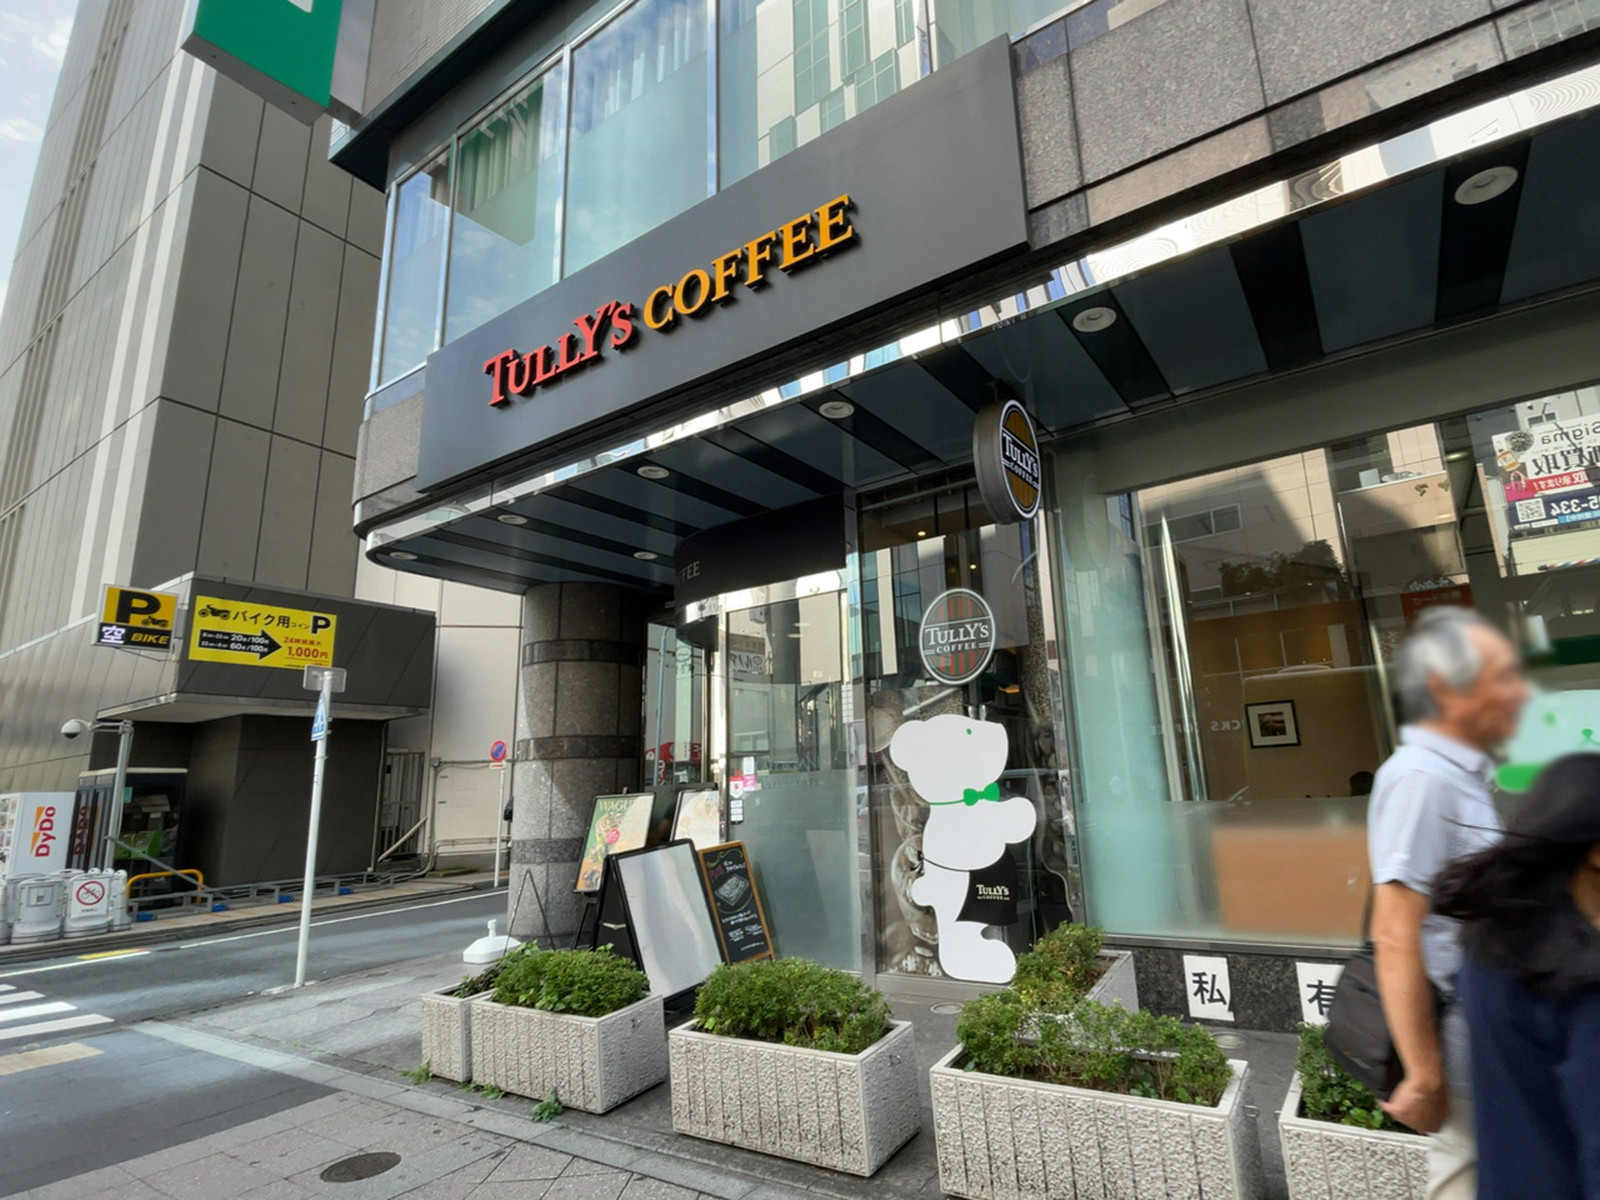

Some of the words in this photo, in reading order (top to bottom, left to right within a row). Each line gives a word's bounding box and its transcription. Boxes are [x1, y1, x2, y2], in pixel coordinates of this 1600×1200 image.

[483, 300, 634, 406] TULLY'S
[643, 193, 854, 330] COFFEE
[1002, 432, 1039, 478] TULLY'S
[116, 589, 161, 624] P
[232, 610, 291, 629] バイク用
[311, 615, 331, 634] P
[925, 622, 989, 645] TULLY'S
[101, 626, 126, 644] 空
[130, 632, 170, 645] BIKE
[287, 646, 328, 659] 1,000円
[936, 642, 977, 654] COFFEE
[35, 806, 56, 857] DyDo
[976, 884, 1010, 896] TULLY'S
[1191, 971, 1228, 1006] 私
